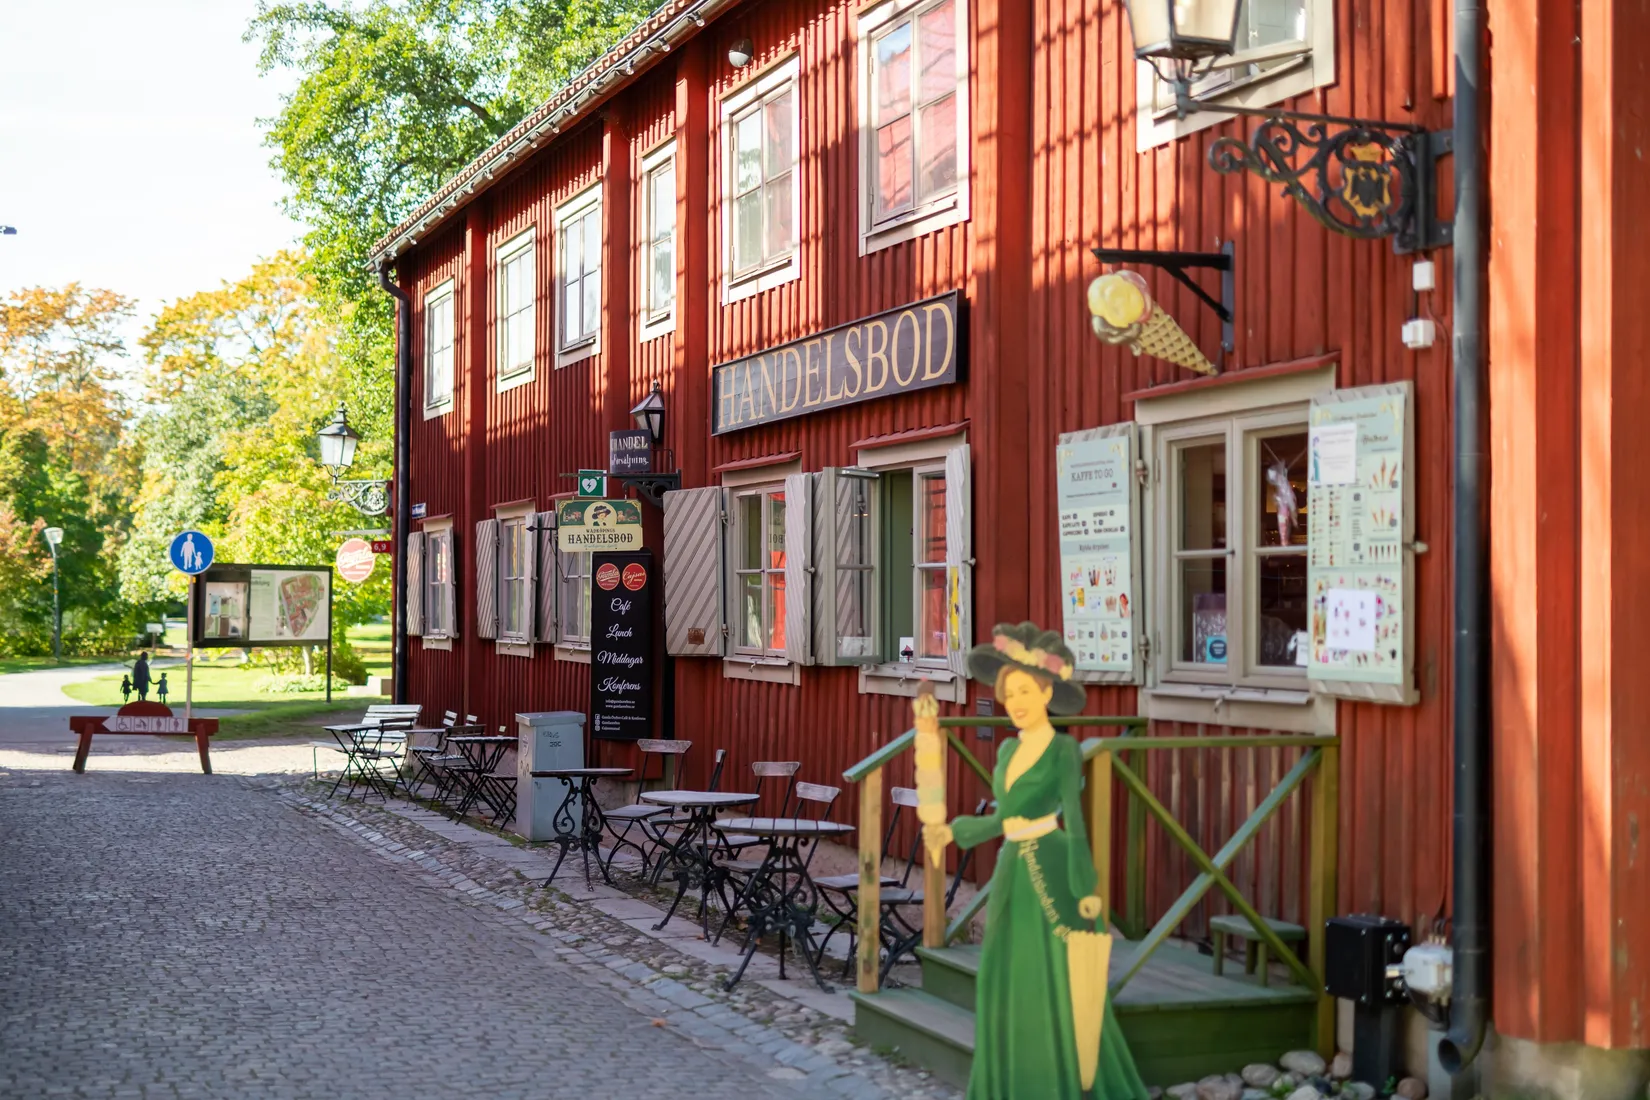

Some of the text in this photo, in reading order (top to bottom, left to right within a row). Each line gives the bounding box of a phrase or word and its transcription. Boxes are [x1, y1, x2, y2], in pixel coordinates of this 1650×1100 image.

[718, 302, 954, 429] HANDELSBOD
[610, 436, 649, 451] HANDEL
[568, 533, 633, 544] HANDELSBOD
[610, 597, 632, 615] Café
[605, 623, 633, 641] Lunch
[597, 650, 644, 668] Middagar
[597, 676, 642, 695] Konferens
